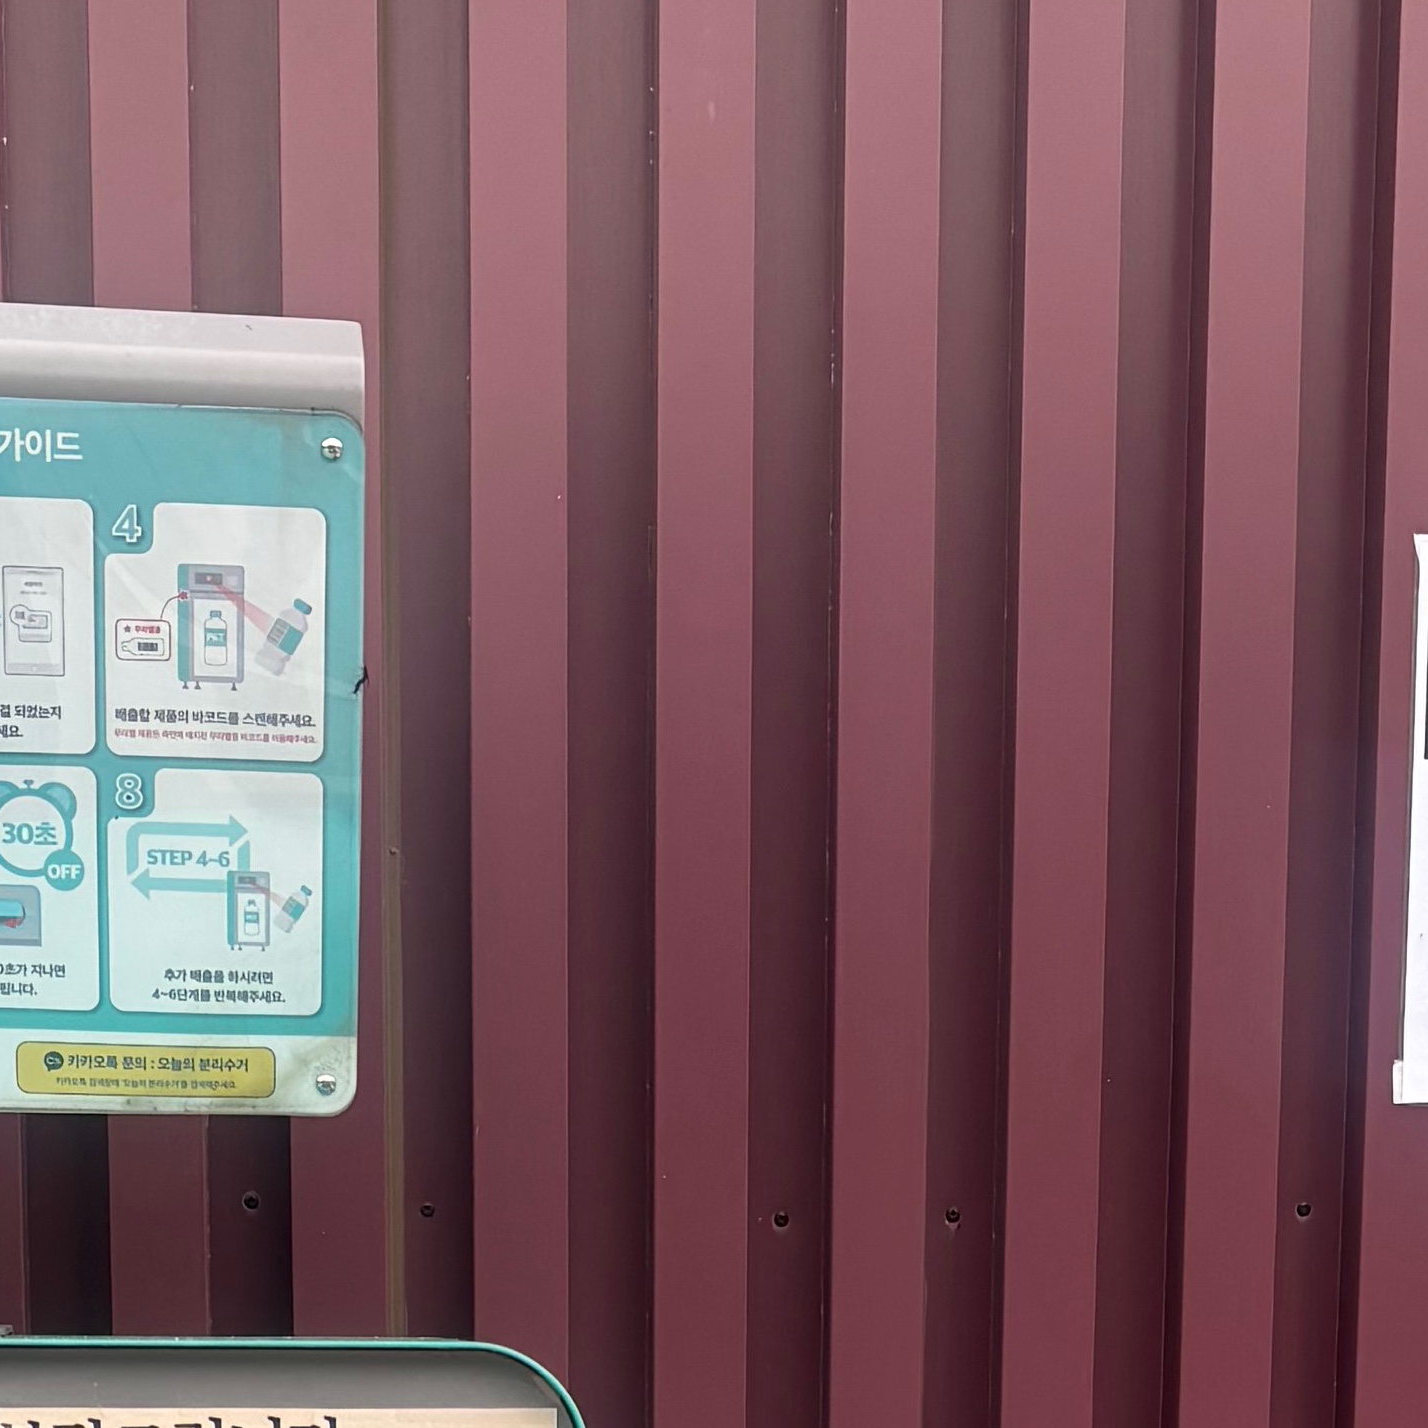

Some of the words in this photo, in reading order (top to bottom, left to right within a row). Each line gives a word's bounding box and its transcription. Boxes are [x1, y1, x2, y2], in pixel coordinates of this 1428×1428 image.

[112, 504, 141, 542] 4
[15, 705, 61, 719] 되었는지
[154, 709, 189, 724] 제품의
[192, 711, 239, 725] 바코드를
[242, 713, 316, 727] 스캔해주세요.
[115, 773, 143, 810] 8
[2, 822, 58, 846] 30초
[147, 850, 192, 866] STEP
[48, 864, 81, 879] OFF
[31, 964, 66, 978] 지나면
[164, 969, 187, 982] 추가
[190, 970, 224, 983] 배출을
[228, 971, 274, 985] 하시려면
[215, 990, 286, 1003] 반복해주세요.
[68, 1054, 117, 1069] 카카오톡
[122, 1056, 147, 1070] 문의
[158, 1058, 195, 1071] 오늘의
[200, 1058, 248, 1072] 분리수거
